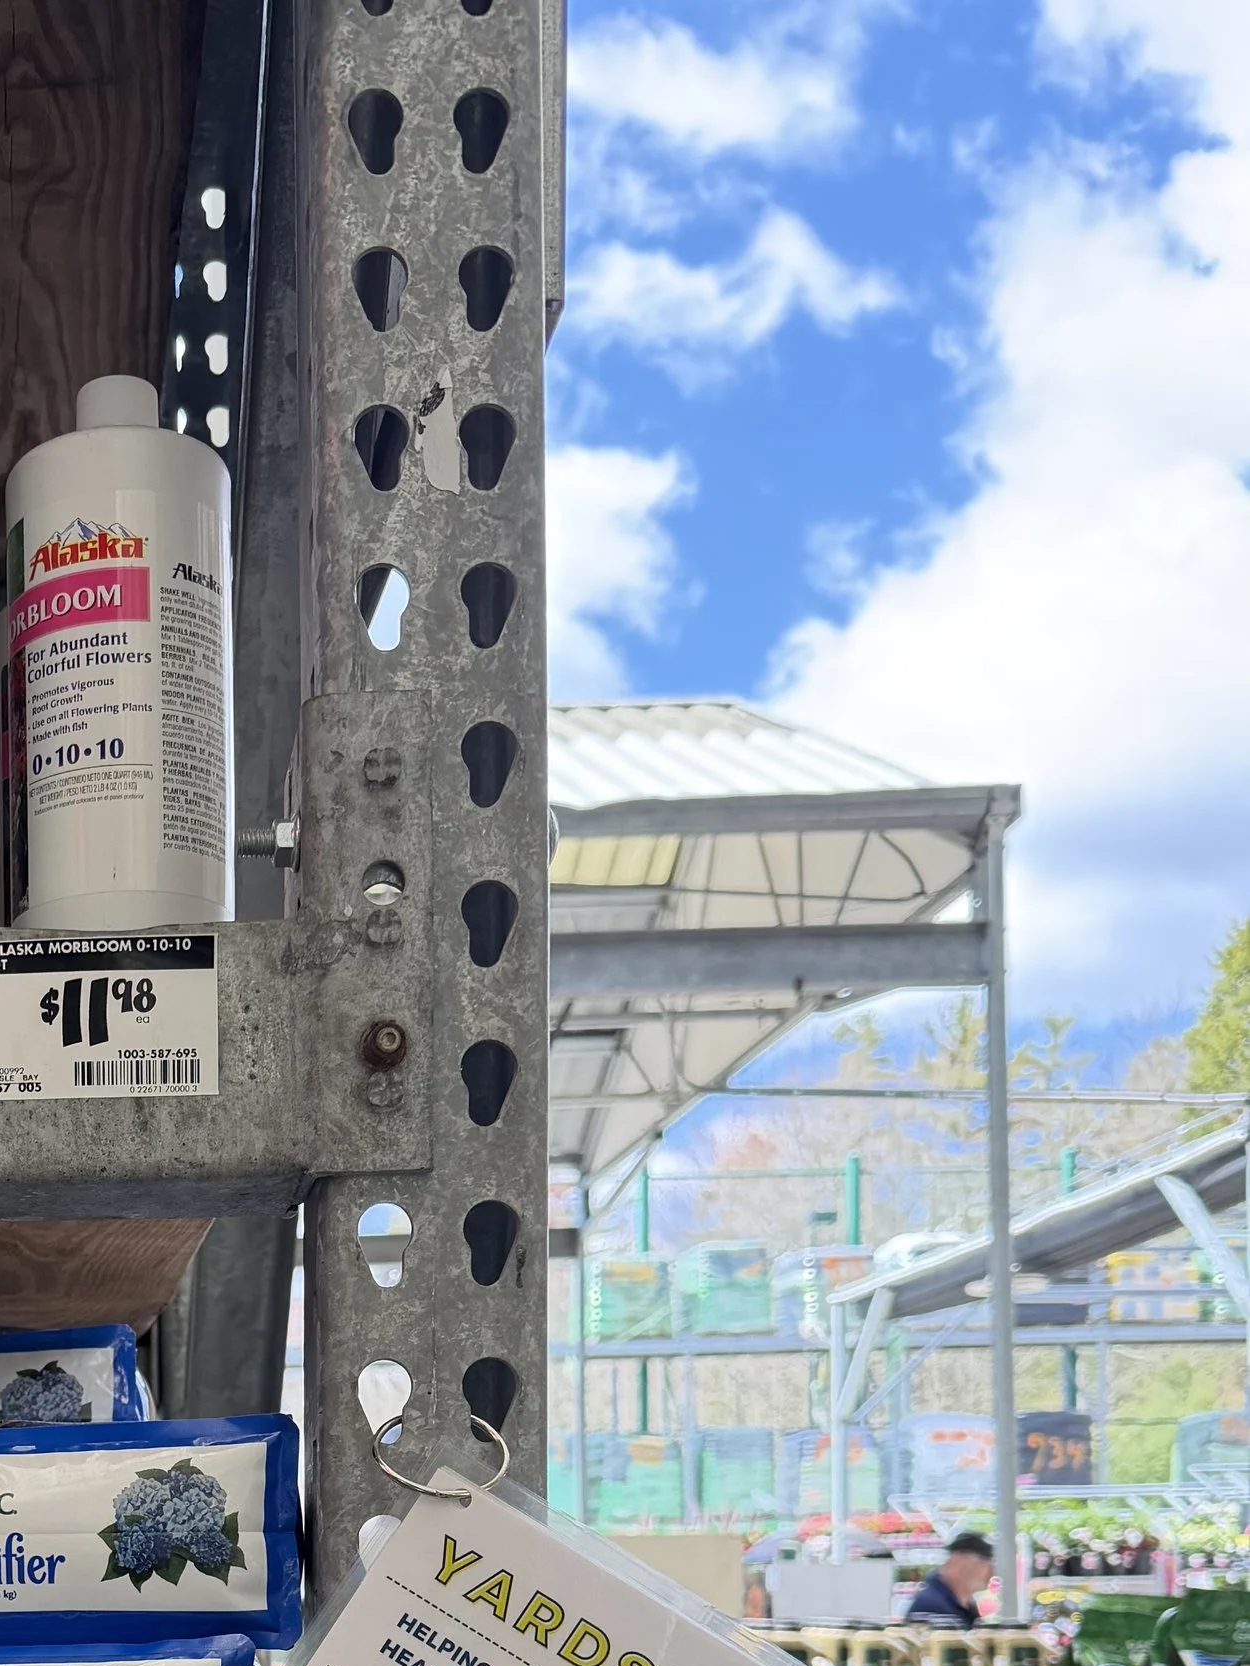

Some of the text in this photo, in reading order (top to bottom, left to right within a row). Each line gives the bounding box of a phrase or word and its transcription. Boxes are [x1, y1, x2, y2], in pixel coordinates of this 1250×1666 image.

[29, 532, 144, 581] Alaska
[27, 632, 128, 667] For Abundant
[28, 651, 152, 684] Colorful Flowers
